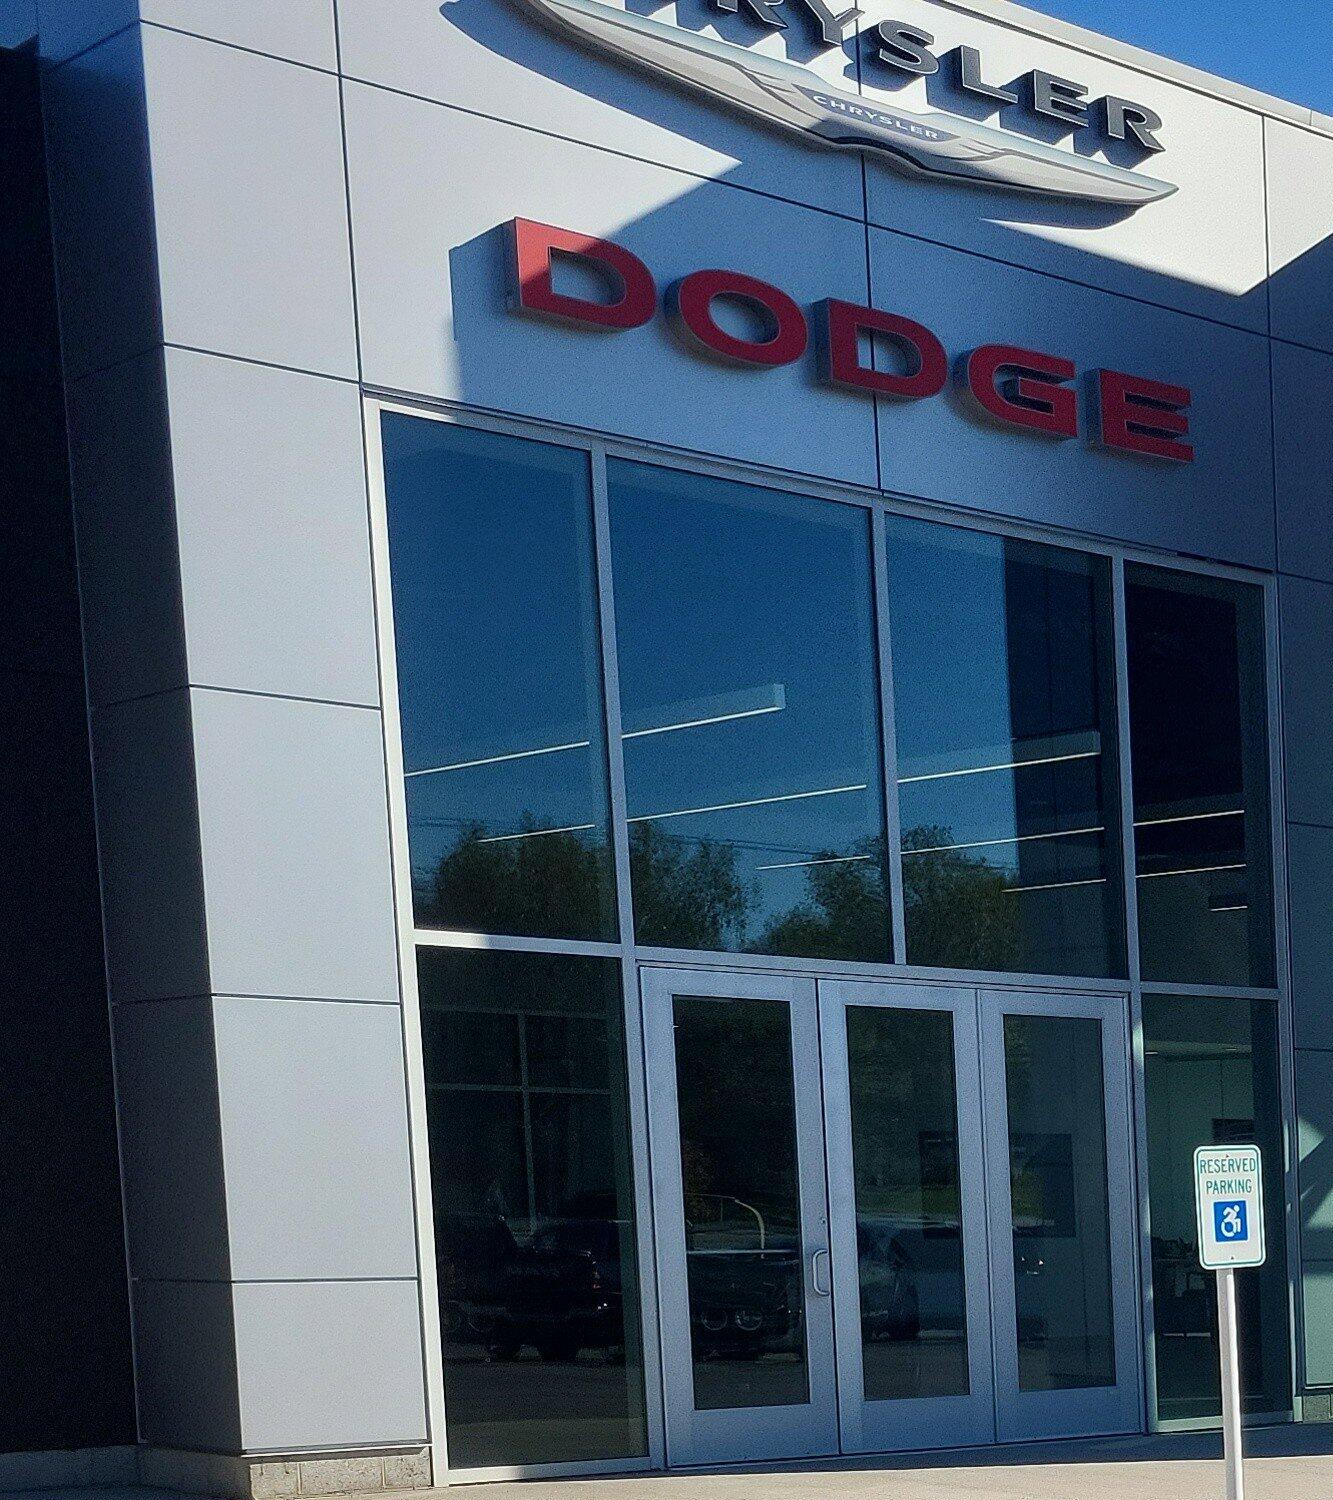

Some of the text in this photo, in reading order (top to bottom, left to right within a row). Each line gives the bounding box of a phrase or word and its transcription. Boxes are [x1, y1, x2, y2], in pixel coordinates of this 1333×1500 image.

[812, 95, 938, 140] CHRYSLER
[513, 216, 1196, 463] DODGE
[1200, 1157, 1256, 1174] RESERVED
[1206, 1179, 1252, 1194] PARKING
